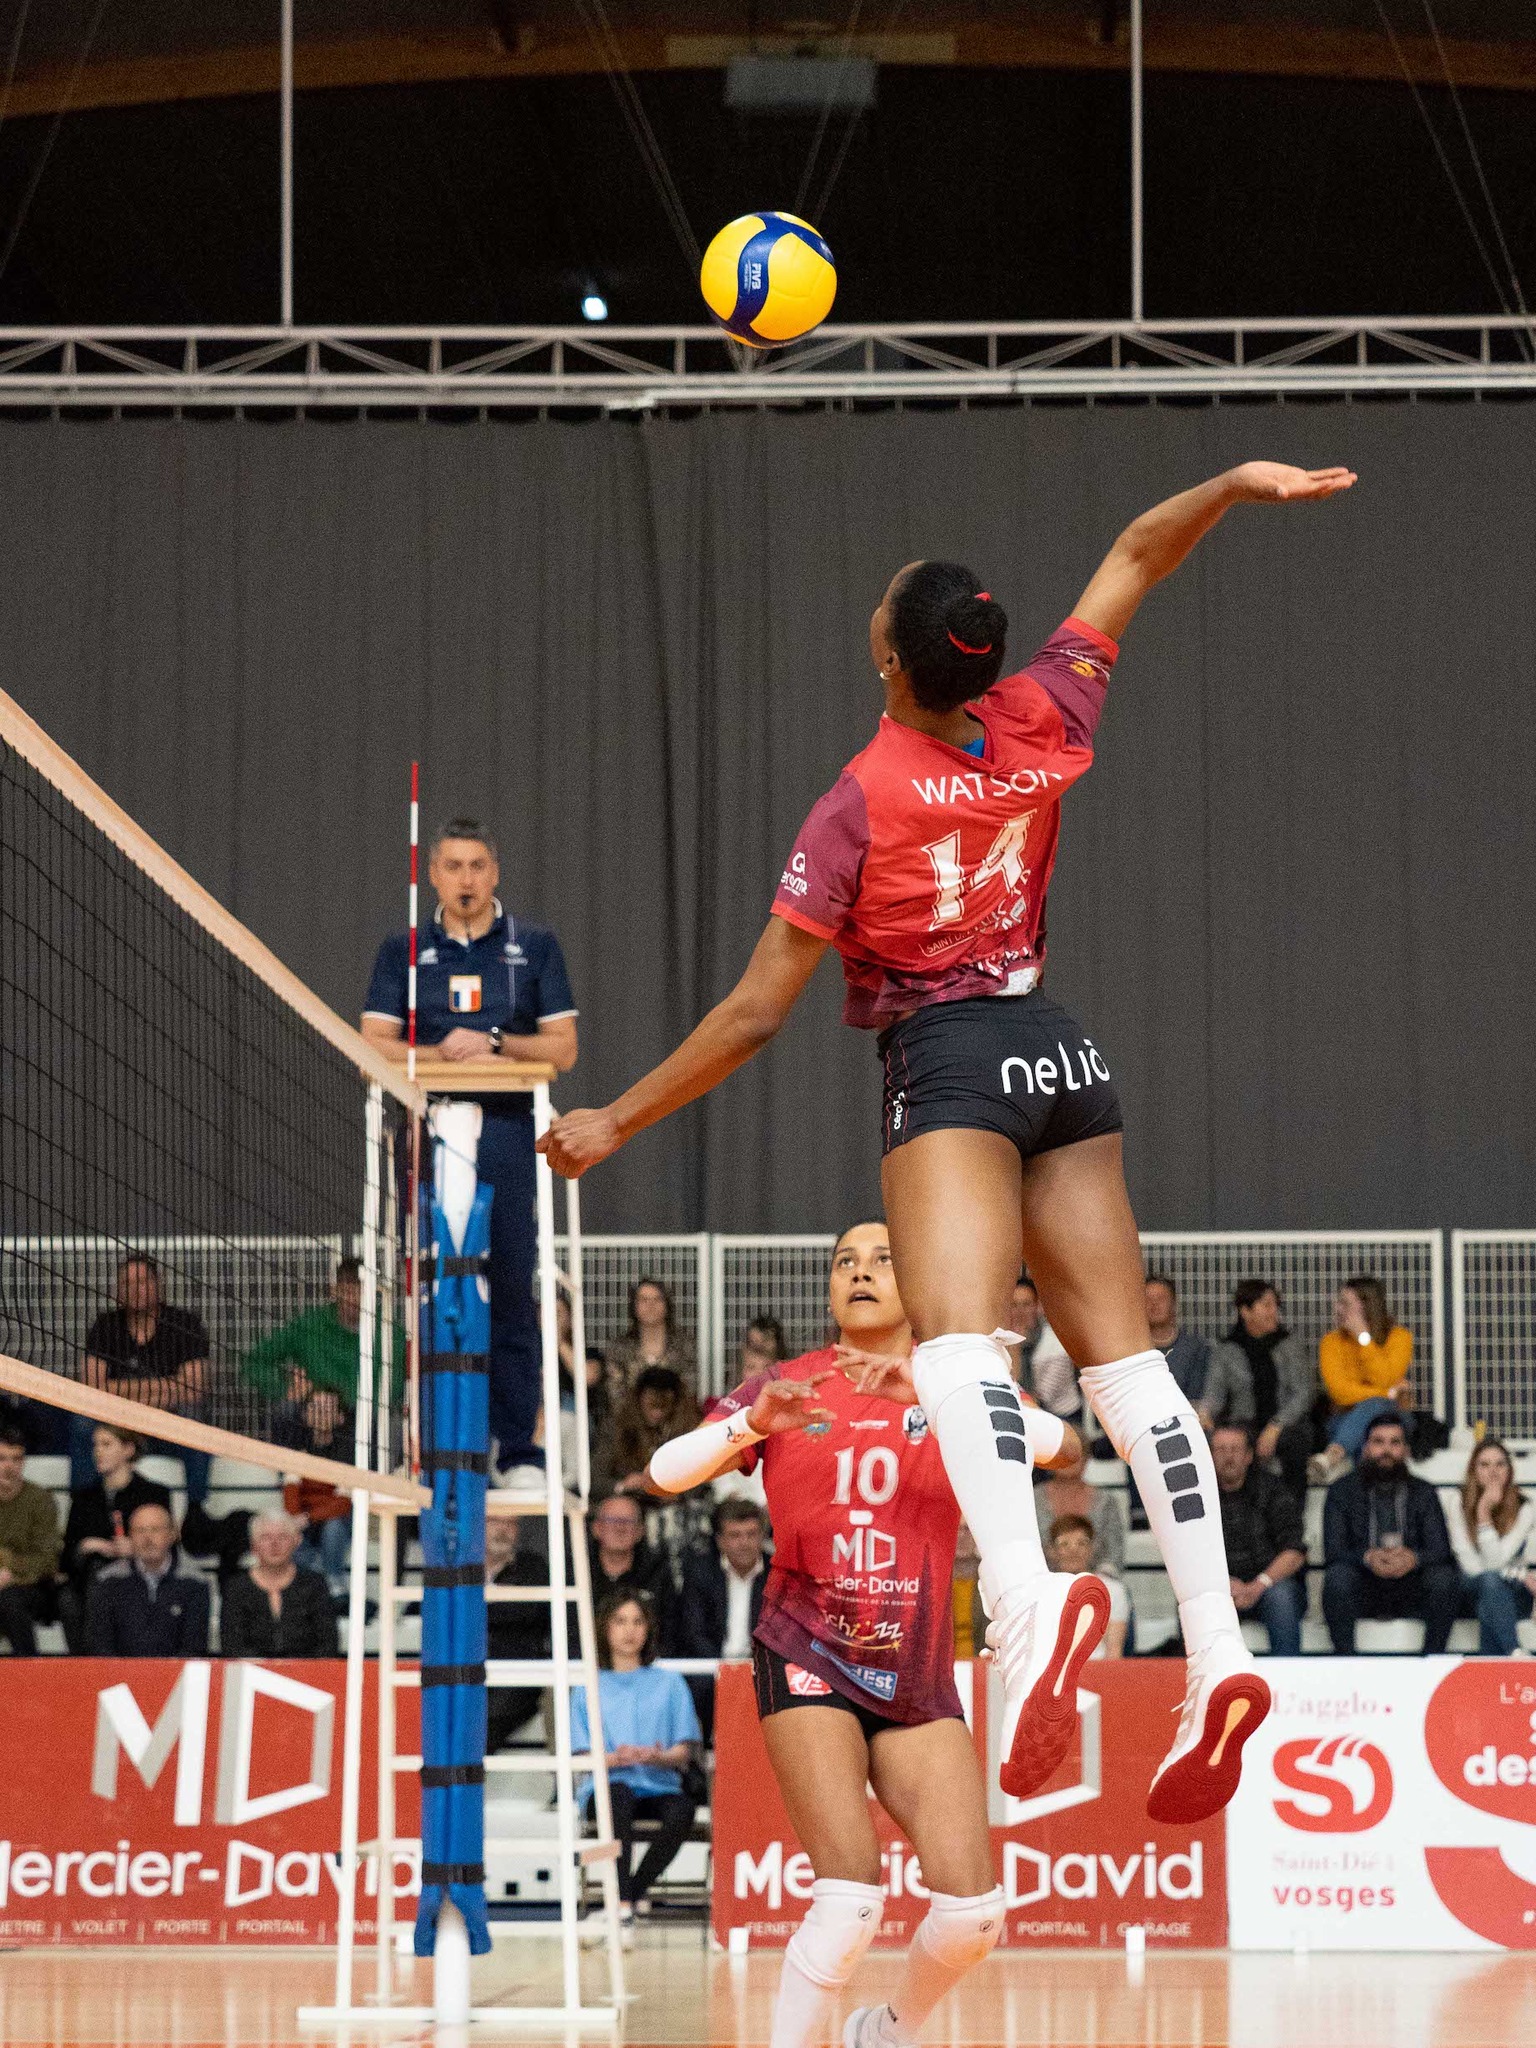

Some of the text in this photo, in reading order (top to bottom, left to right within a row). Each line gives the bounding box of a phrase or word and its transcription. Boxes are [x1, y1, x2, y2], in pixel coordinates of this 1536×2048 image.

[751, 262, 762, 290] FIVB
[911, 769, 1063, 805] WATSON
[920, 808, 1037, 933] 14
[830, 1445, 899, 1505] 10
[832, 1527, 896, 1572] MD
[91, 1661, 335, 1827] MD
[0, 1839, 421, 1908] ercier-David
[1272, 1885, 1397, 1914] vosges
[71, 1919, 129, 1935] VOLET
[153, 1919, 211, 1935] PORTE
[235, 1919, 309, 1935] PORTAIL
[1016, 1921, 1090, 1936] PORTAIL
